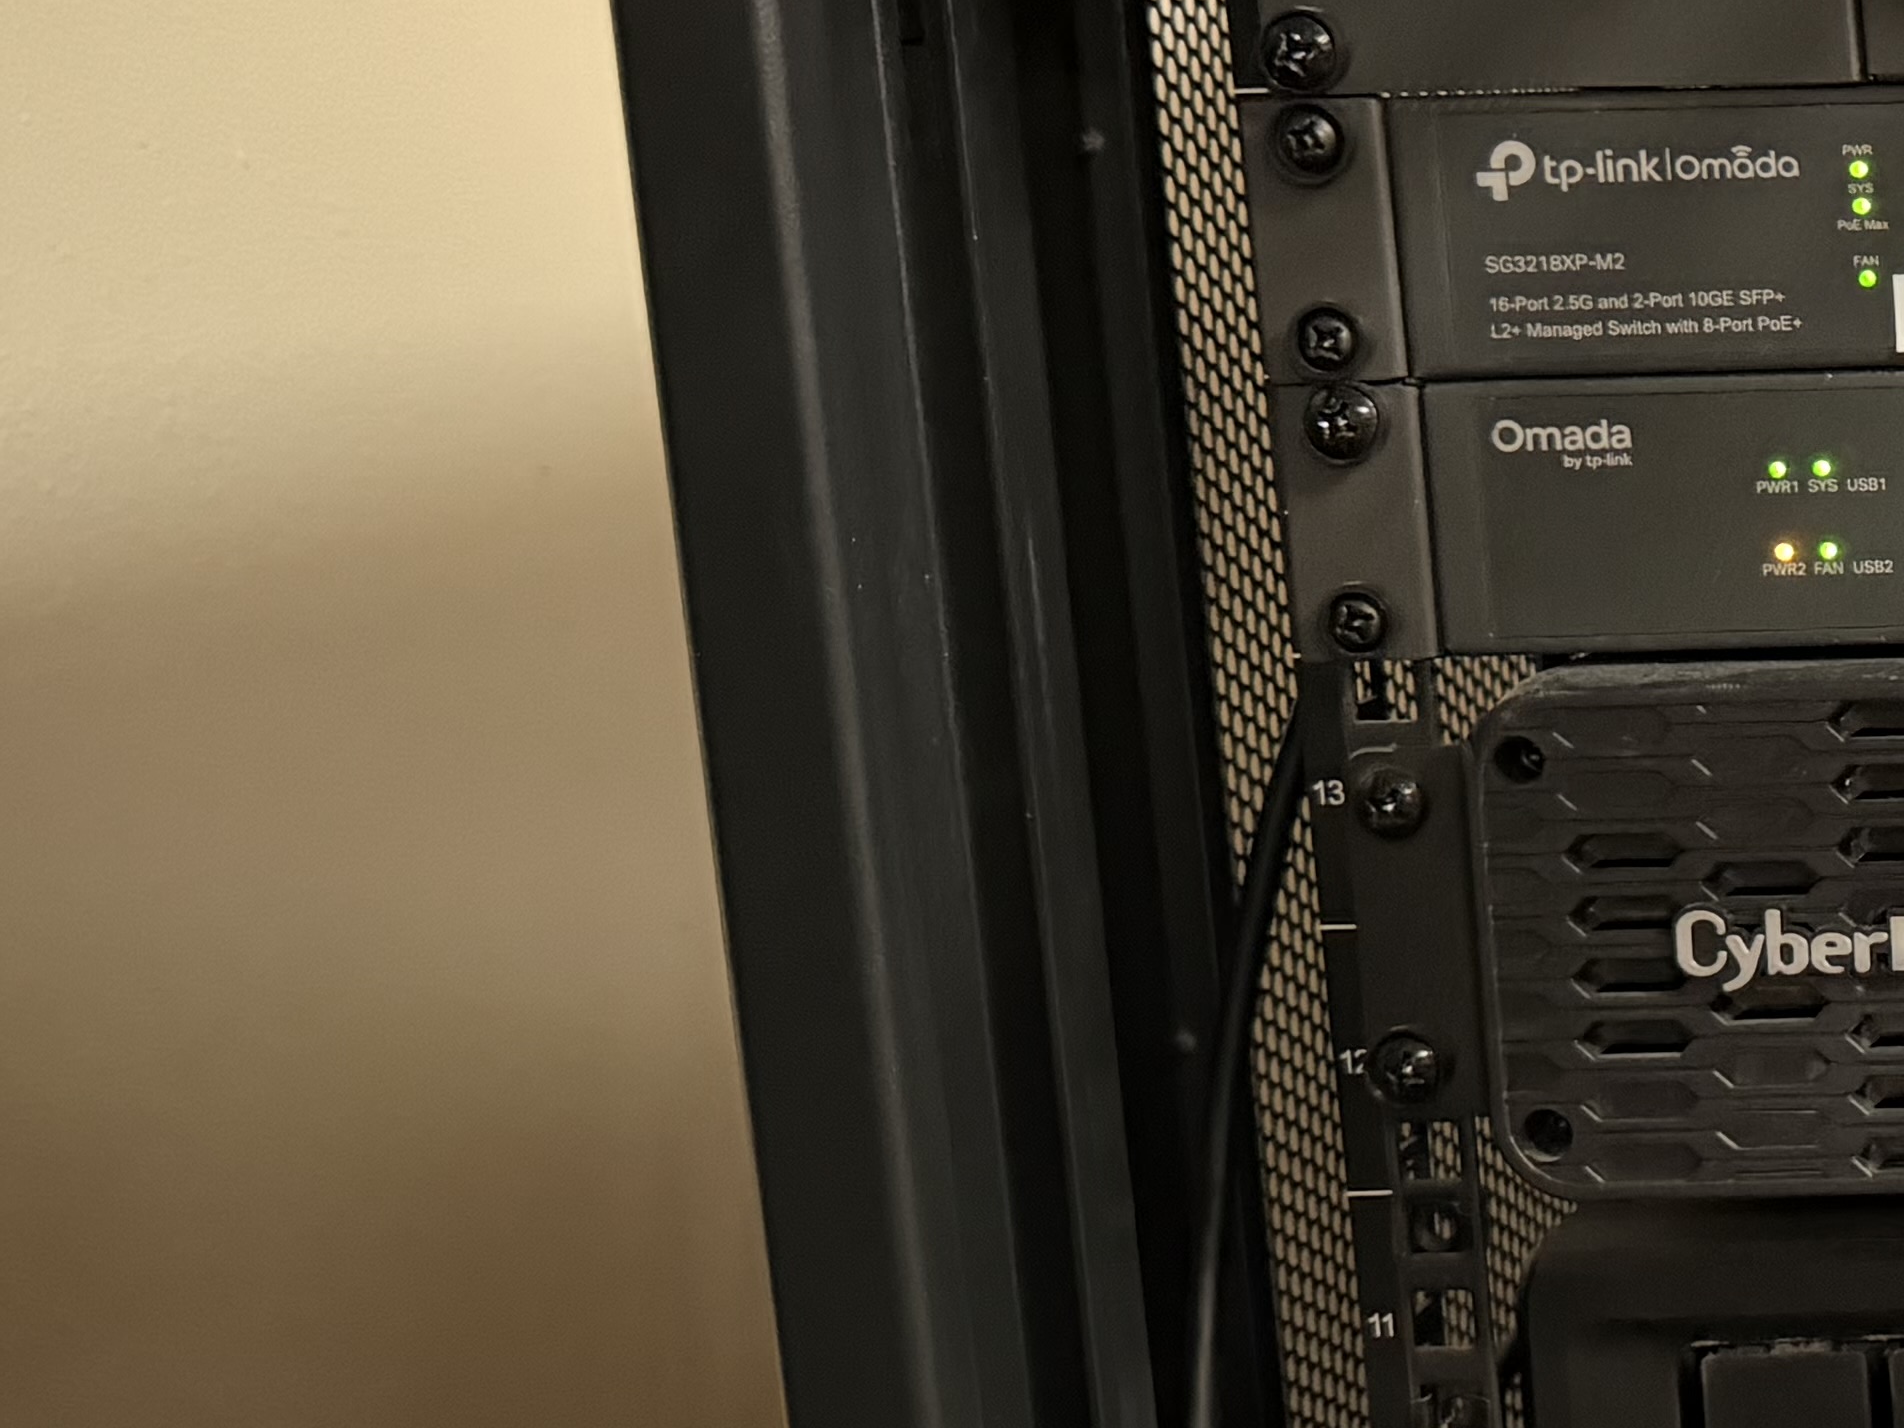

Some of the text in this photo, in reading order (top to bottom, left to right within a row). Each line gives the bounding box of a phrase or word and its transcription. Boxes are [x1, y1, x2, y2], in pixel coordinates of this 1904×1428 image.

[1842, 144, 1872, 156] PWR
[1542, 150, 1661, 189] tp-link
[1848, 183, 1874, 194] SYS
[1838, 220, 1889, 231] PoE Max
[1486, 253, 1626, 274] SG3218XP-M2
[1853, 255, 1879, 267] FAN
[1490, 290, 1786, 312] 16-Port 2.5G and 2-Port 10GE SFP+
[1490, 315, 1803, 341] L2+ Managed Switch with 8-Port PoE+
[1492, 419, 1632, 452] Omada
[1563, 453, 1632, 470] by tp-link
[1756, 477, 1887, 494] PWR1 SYS USB1
[1762, 560, 1894, 576] PWR2 FAN USB2
[1312, 781, 1345, 805] 13
[1367, 1314, 1395, 1338] 11
